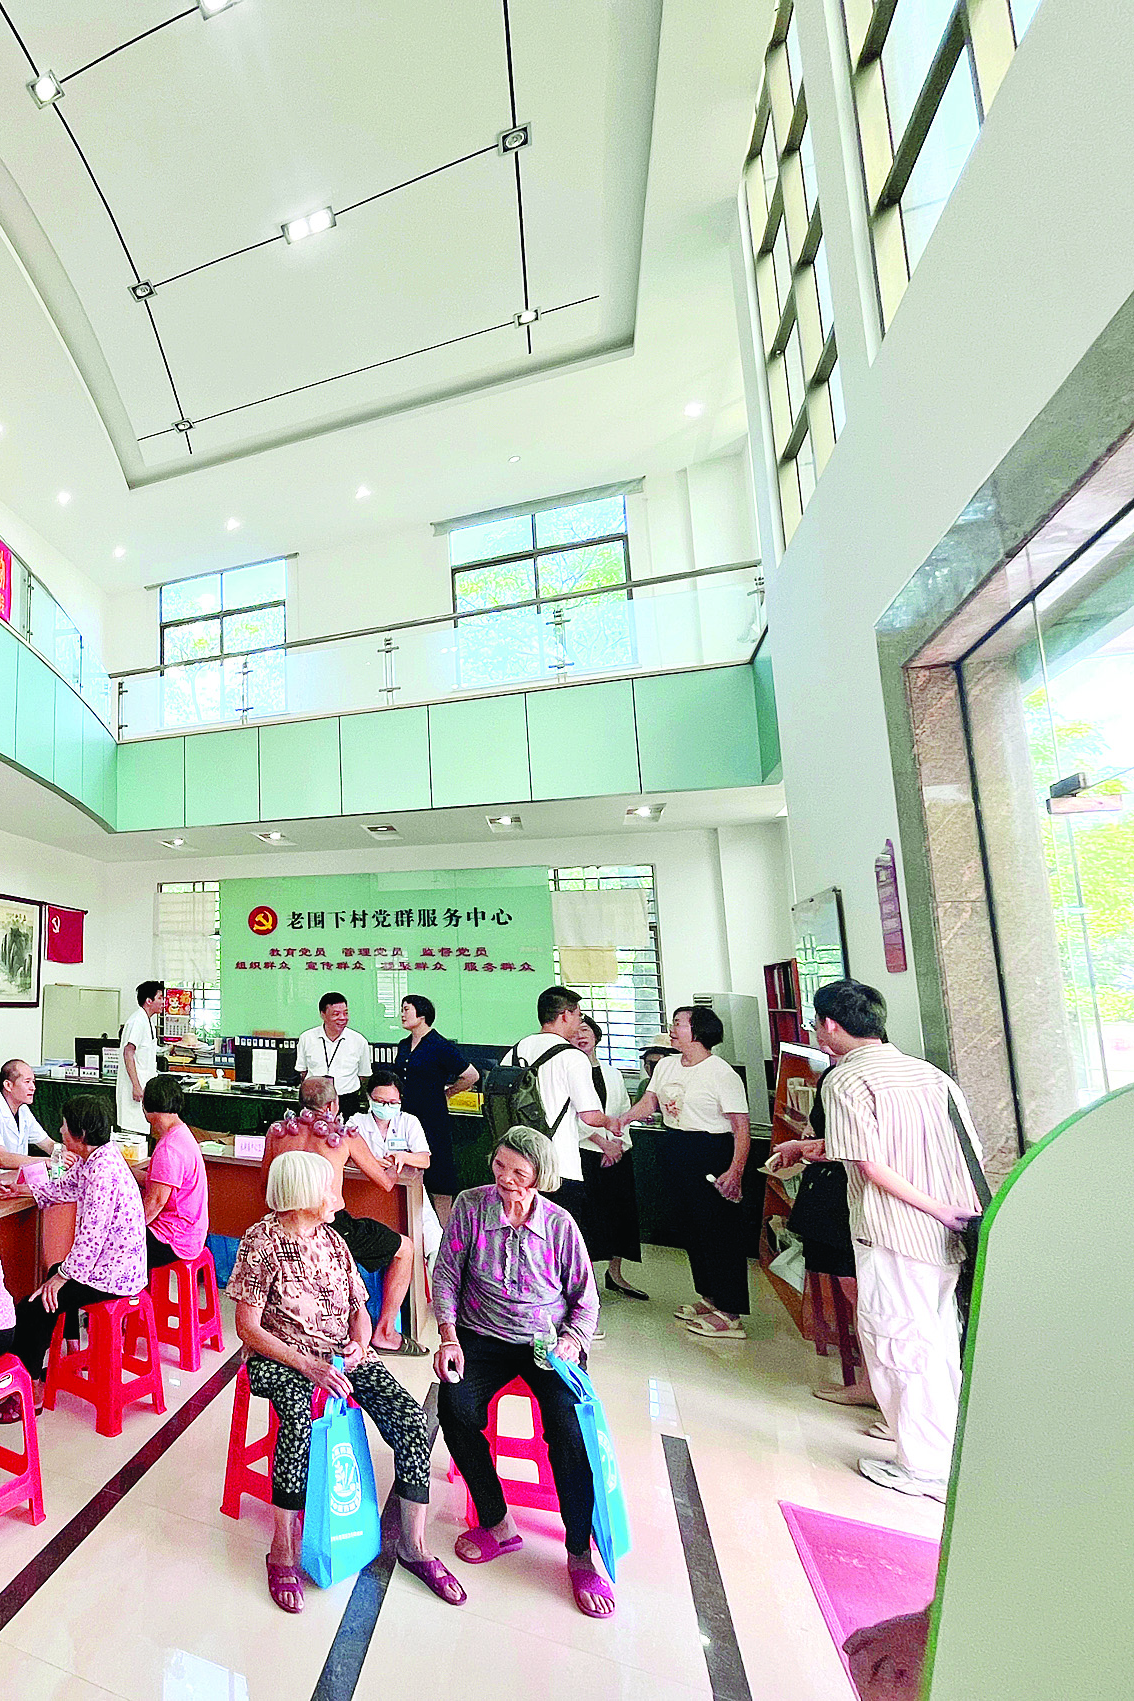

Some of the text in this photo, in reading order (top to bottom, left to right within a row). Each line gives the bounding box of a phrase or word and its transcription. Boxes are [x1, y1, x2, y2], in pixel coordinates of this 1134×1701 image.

[268, 946, 489, 958] 教育党员 管理党员 监督党员
[234, 961, 292, 971] 组织群众
[304, 960, 367, 971] 宣传群众
[463, 960, 536, 972] 服务群众
